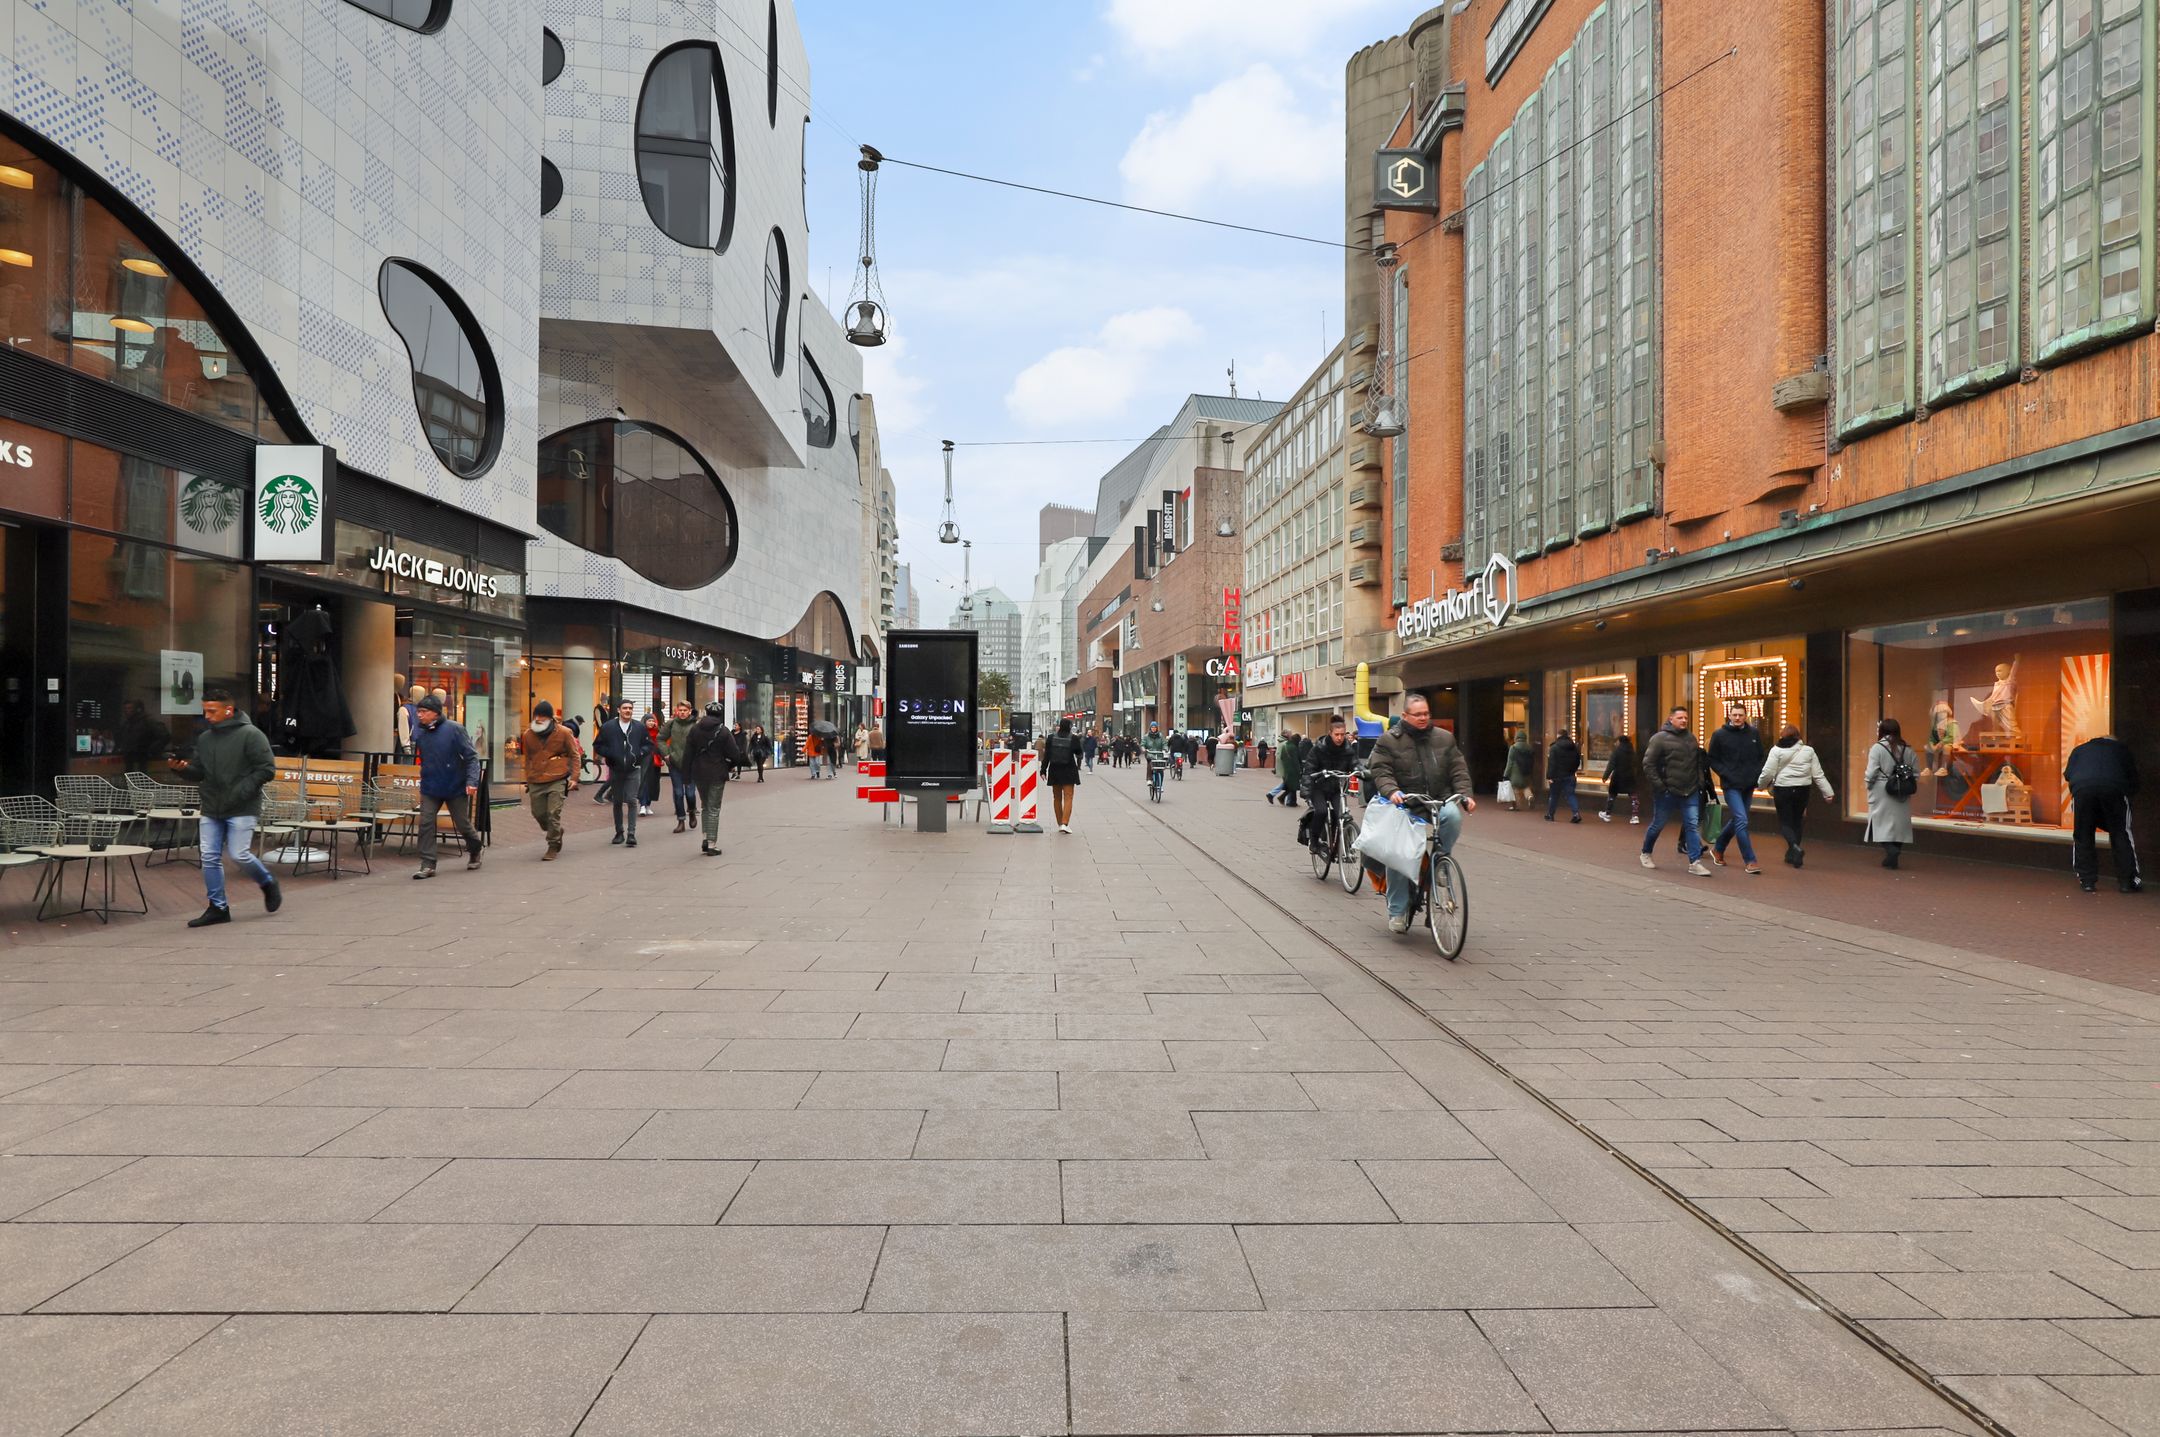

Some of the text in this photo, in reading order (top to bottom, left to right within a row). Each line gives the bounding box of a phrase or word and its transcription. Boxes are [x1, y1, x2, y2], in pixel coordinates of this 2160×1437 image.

[370, 546, 498, 598] JACK JONES
[1223, 588, 1241, 677] HEMA
[665, 646, 697, 661] COSTES
[1206, 656, 1239, 677] C&A
[835, 664, 847, 691] snipes
[1281, 671, 1304, 697] HEMA
[1713, 676, 1773, 699] CHARLOTTE
